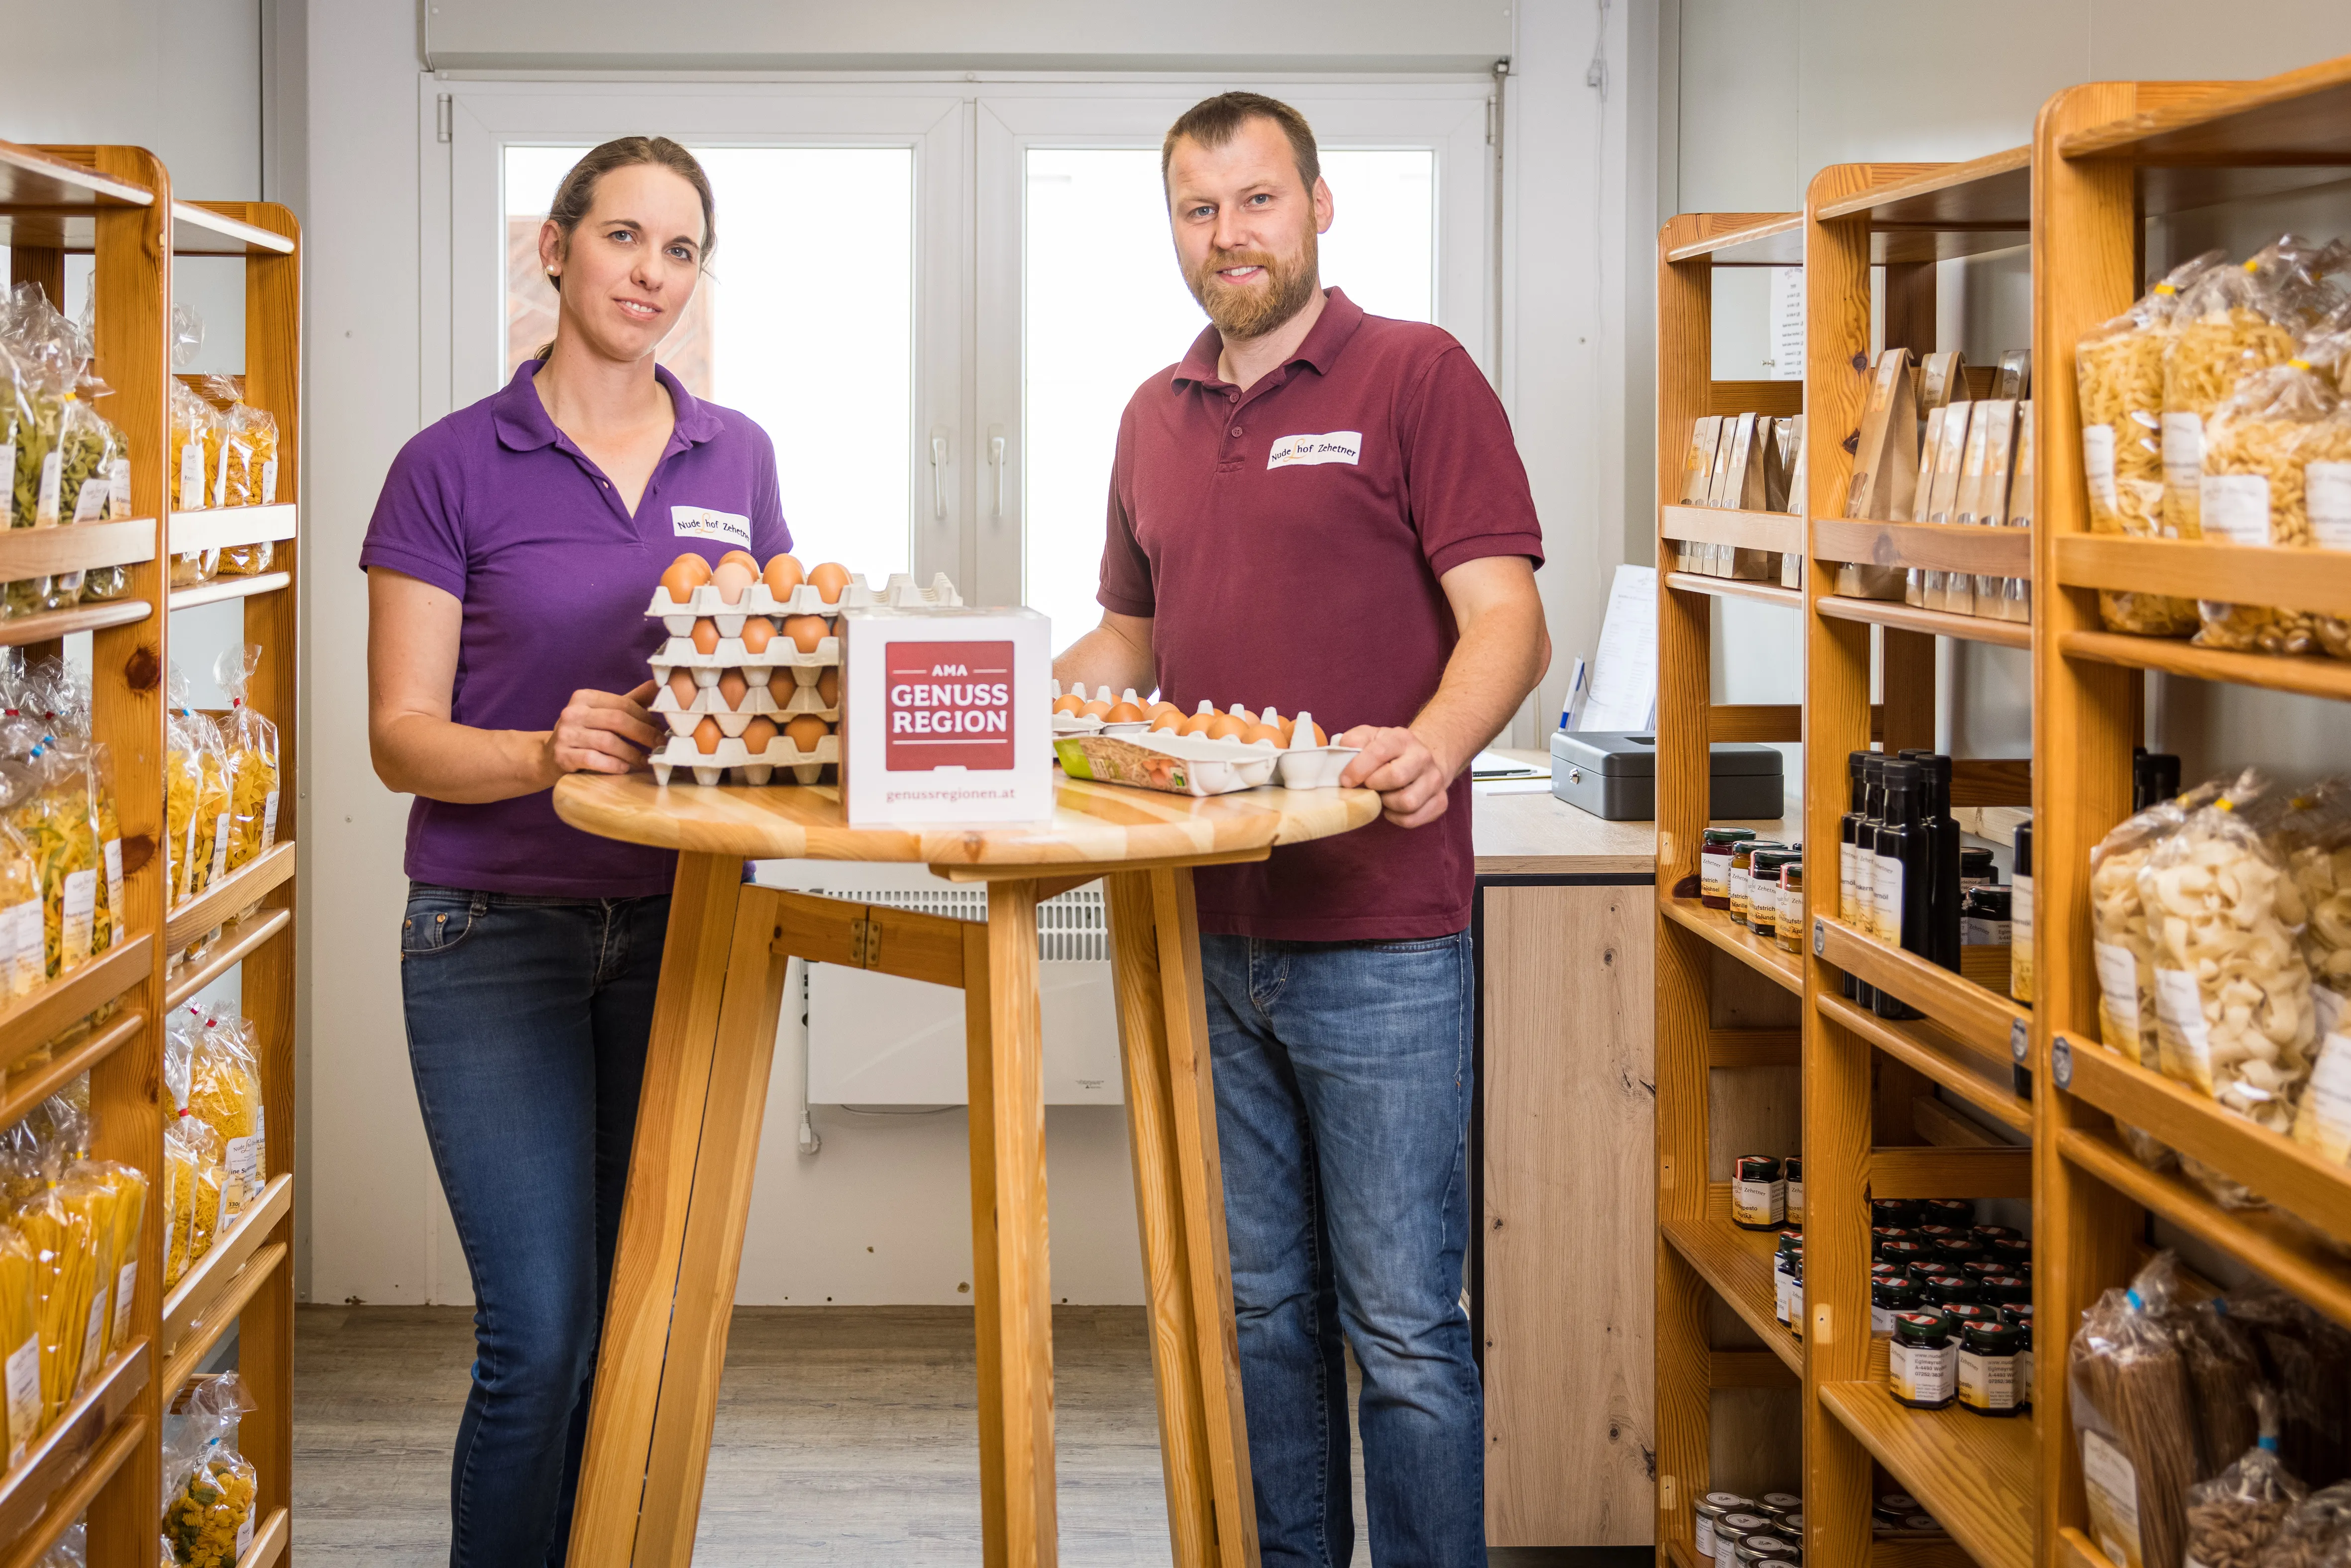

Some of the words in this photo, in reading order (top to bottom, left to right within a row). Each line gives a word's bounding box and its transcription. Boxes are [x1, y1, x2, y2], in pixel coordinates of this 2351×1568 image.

[1318, 443, 1356, 457] Zehetner
[723, 523, 749, 542] Zehetne
[932, 664, 968, 677] AMA
[891, 684, 1009, 707] GENUSS
[892, 711, 1008, 733] REGION
[886, 788, 1015, 803] genussregionen.at
[1703, 858, 1721, 868] Zehetner
[1969, 924, 1990, 935] Zehetner
[1744, 1187, 1766, 1196] Zehetner
[1960, 1357, 1979, 1371] Zehetner
